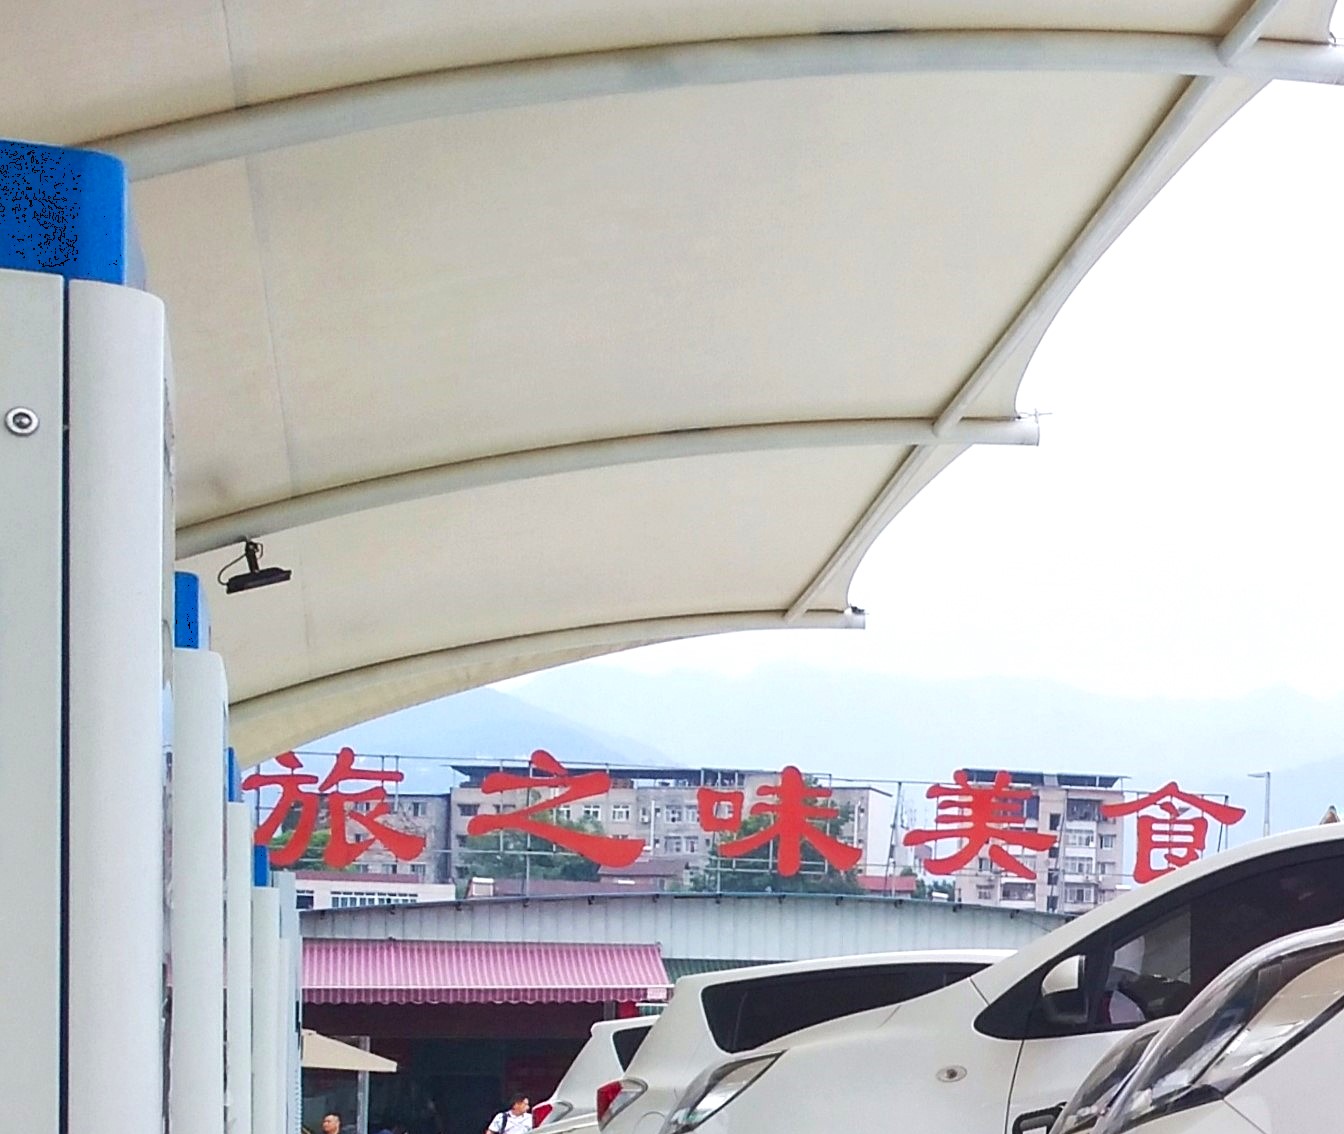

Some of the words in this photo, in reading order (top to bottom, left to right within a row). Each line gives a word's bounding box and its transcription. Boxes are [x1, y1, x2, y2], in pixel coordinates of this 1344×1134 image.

[241, 746, 1247, 885] 旅之味美食
